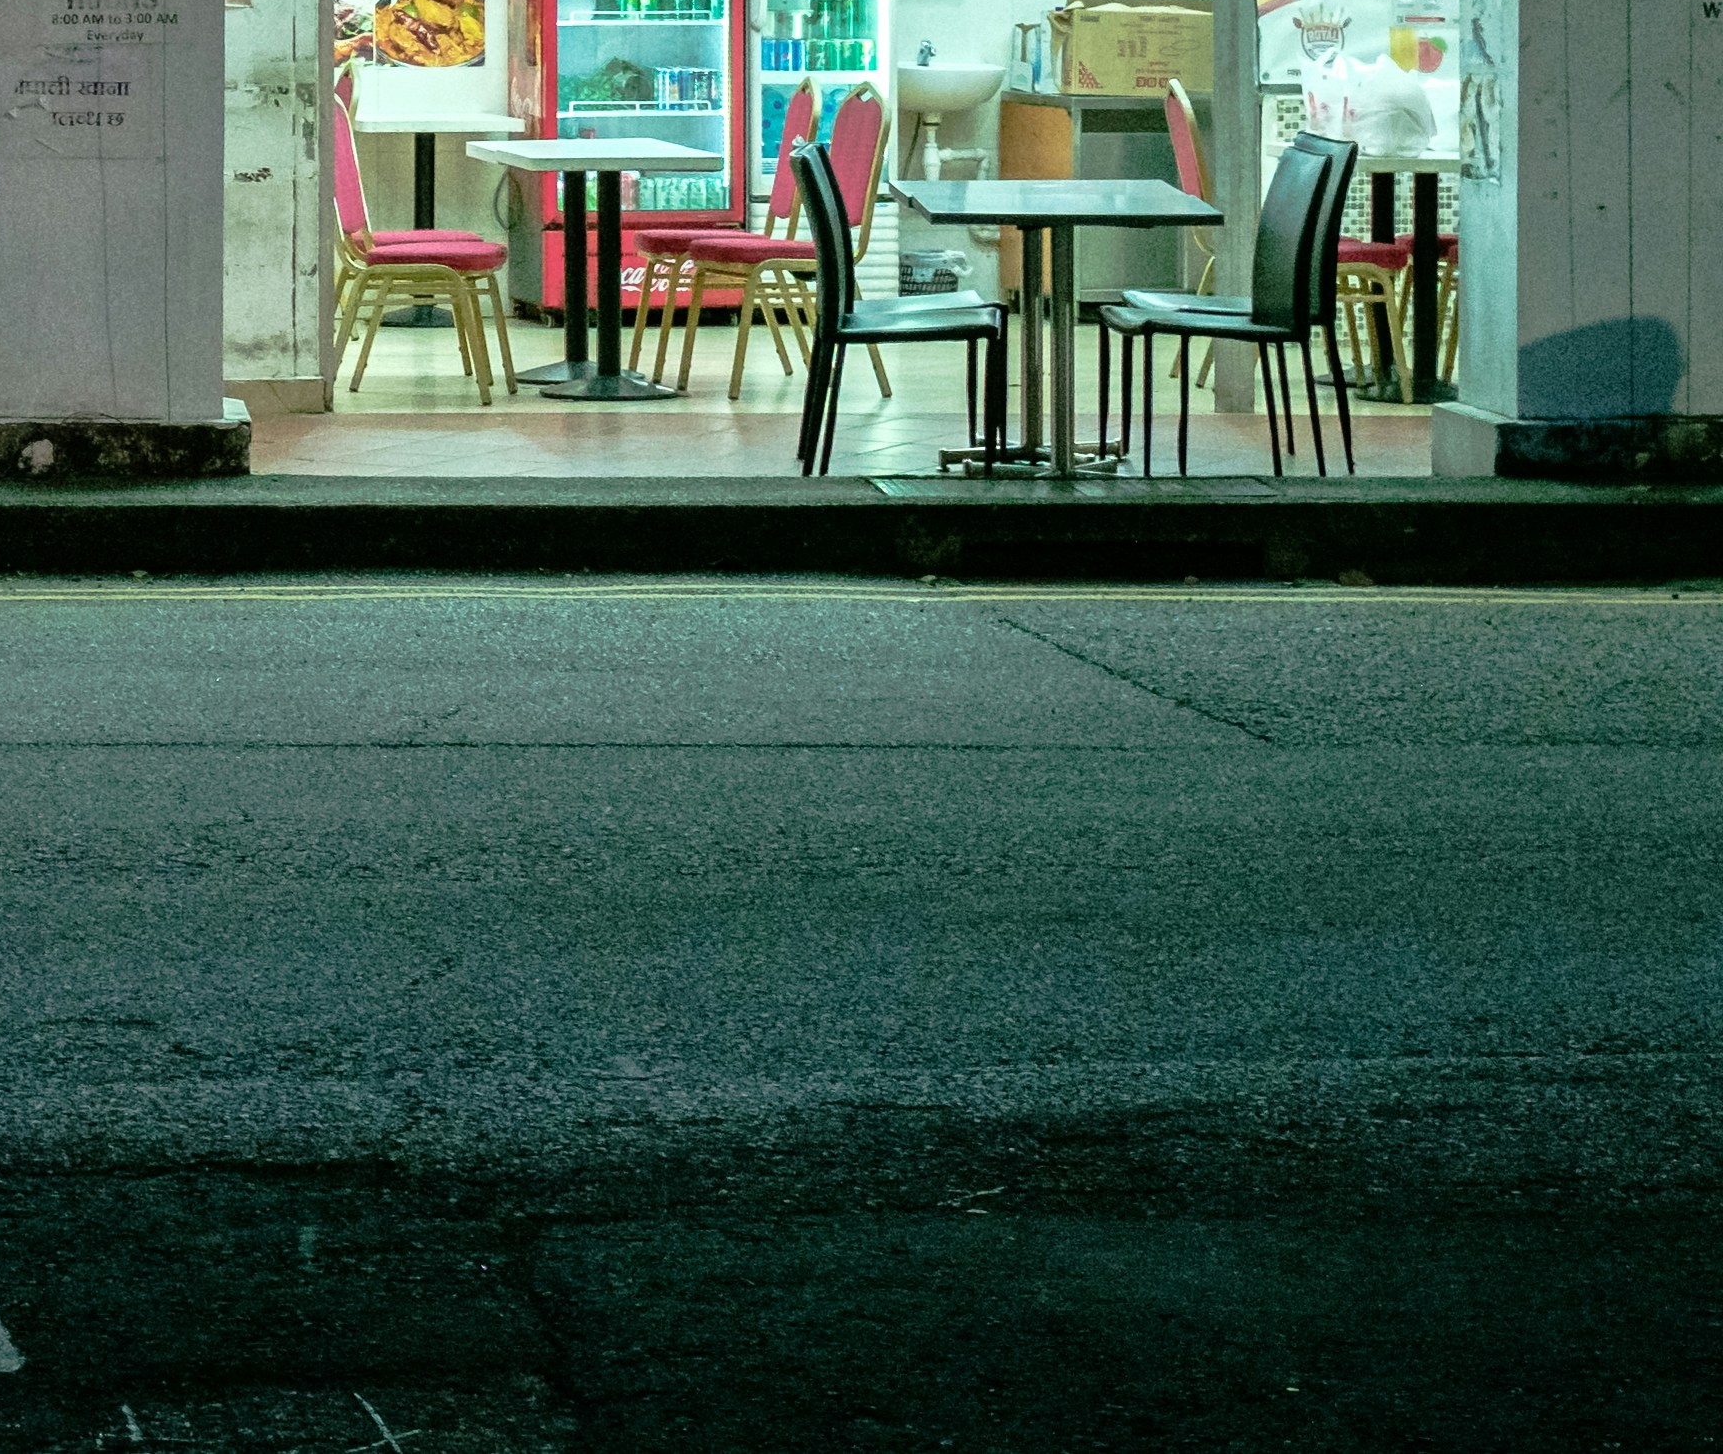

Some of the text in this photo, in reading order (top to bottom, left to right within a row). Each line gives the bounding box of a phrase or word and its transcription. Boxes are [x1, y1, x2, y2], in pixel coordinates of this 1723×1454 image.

[82, 13, 105, 25] AM
[108, 13, 122, 25] to
[125, 13, 153, 25] 3:00
[156, 13, 179, 25] AM
